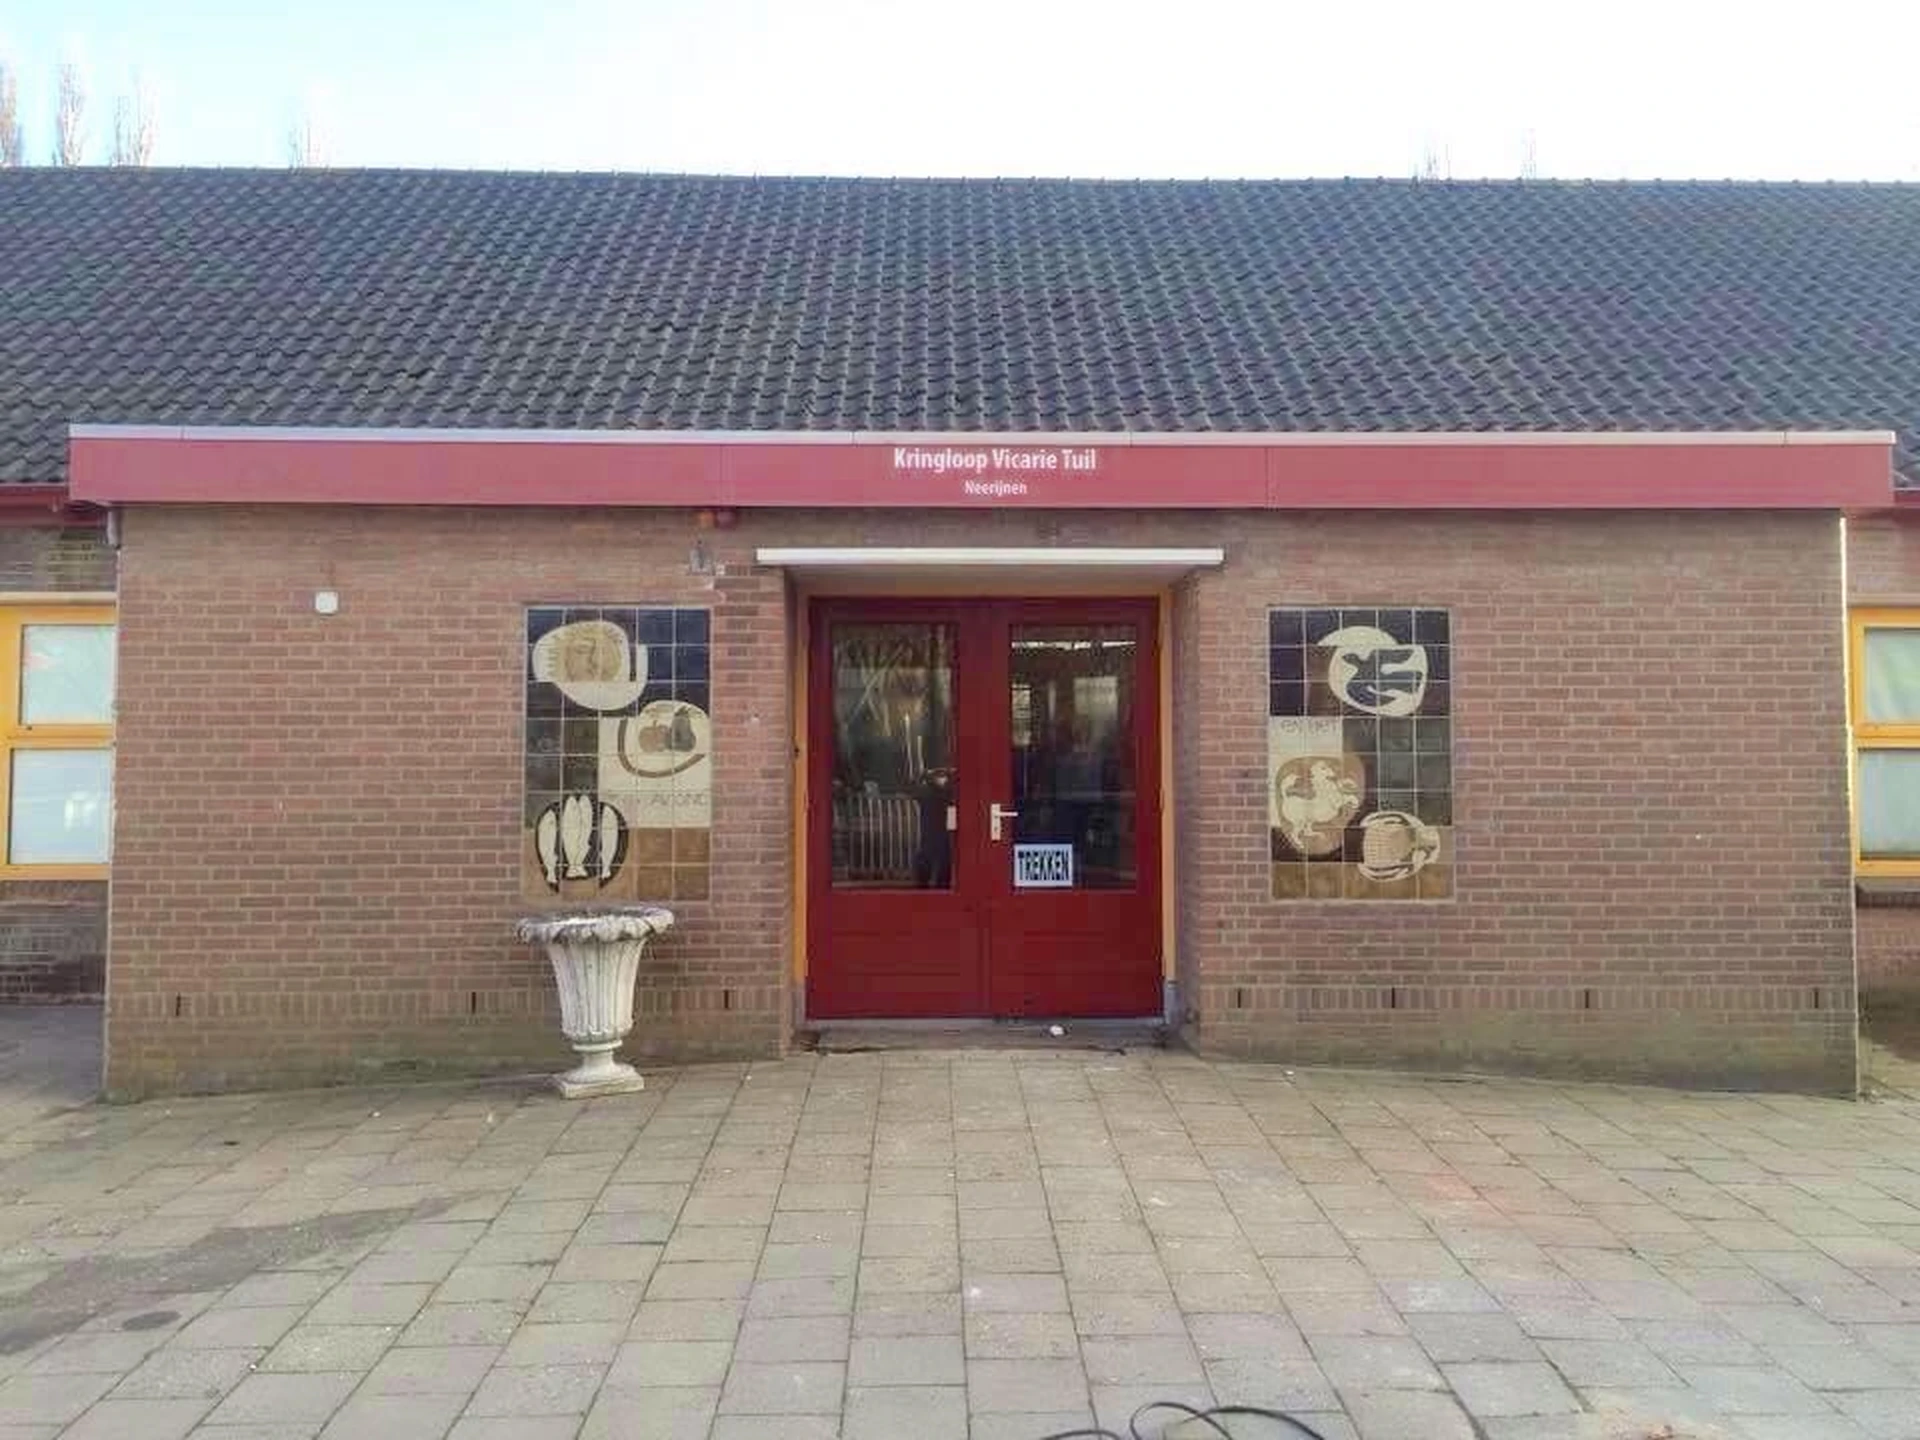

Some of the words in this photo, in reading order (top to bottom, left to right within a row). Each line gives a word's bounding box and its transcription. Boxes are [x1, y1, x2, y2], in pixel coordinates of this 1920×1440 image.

[894, 448, 988, 473] Kringloop
[992, 448, 1057, 470] Vicarie
[1061, 448, 1097, 470] Tuil
[964, 480, 1028, 497] Neerijnen
[1018, 850, 1069, 881] TREKKEN
